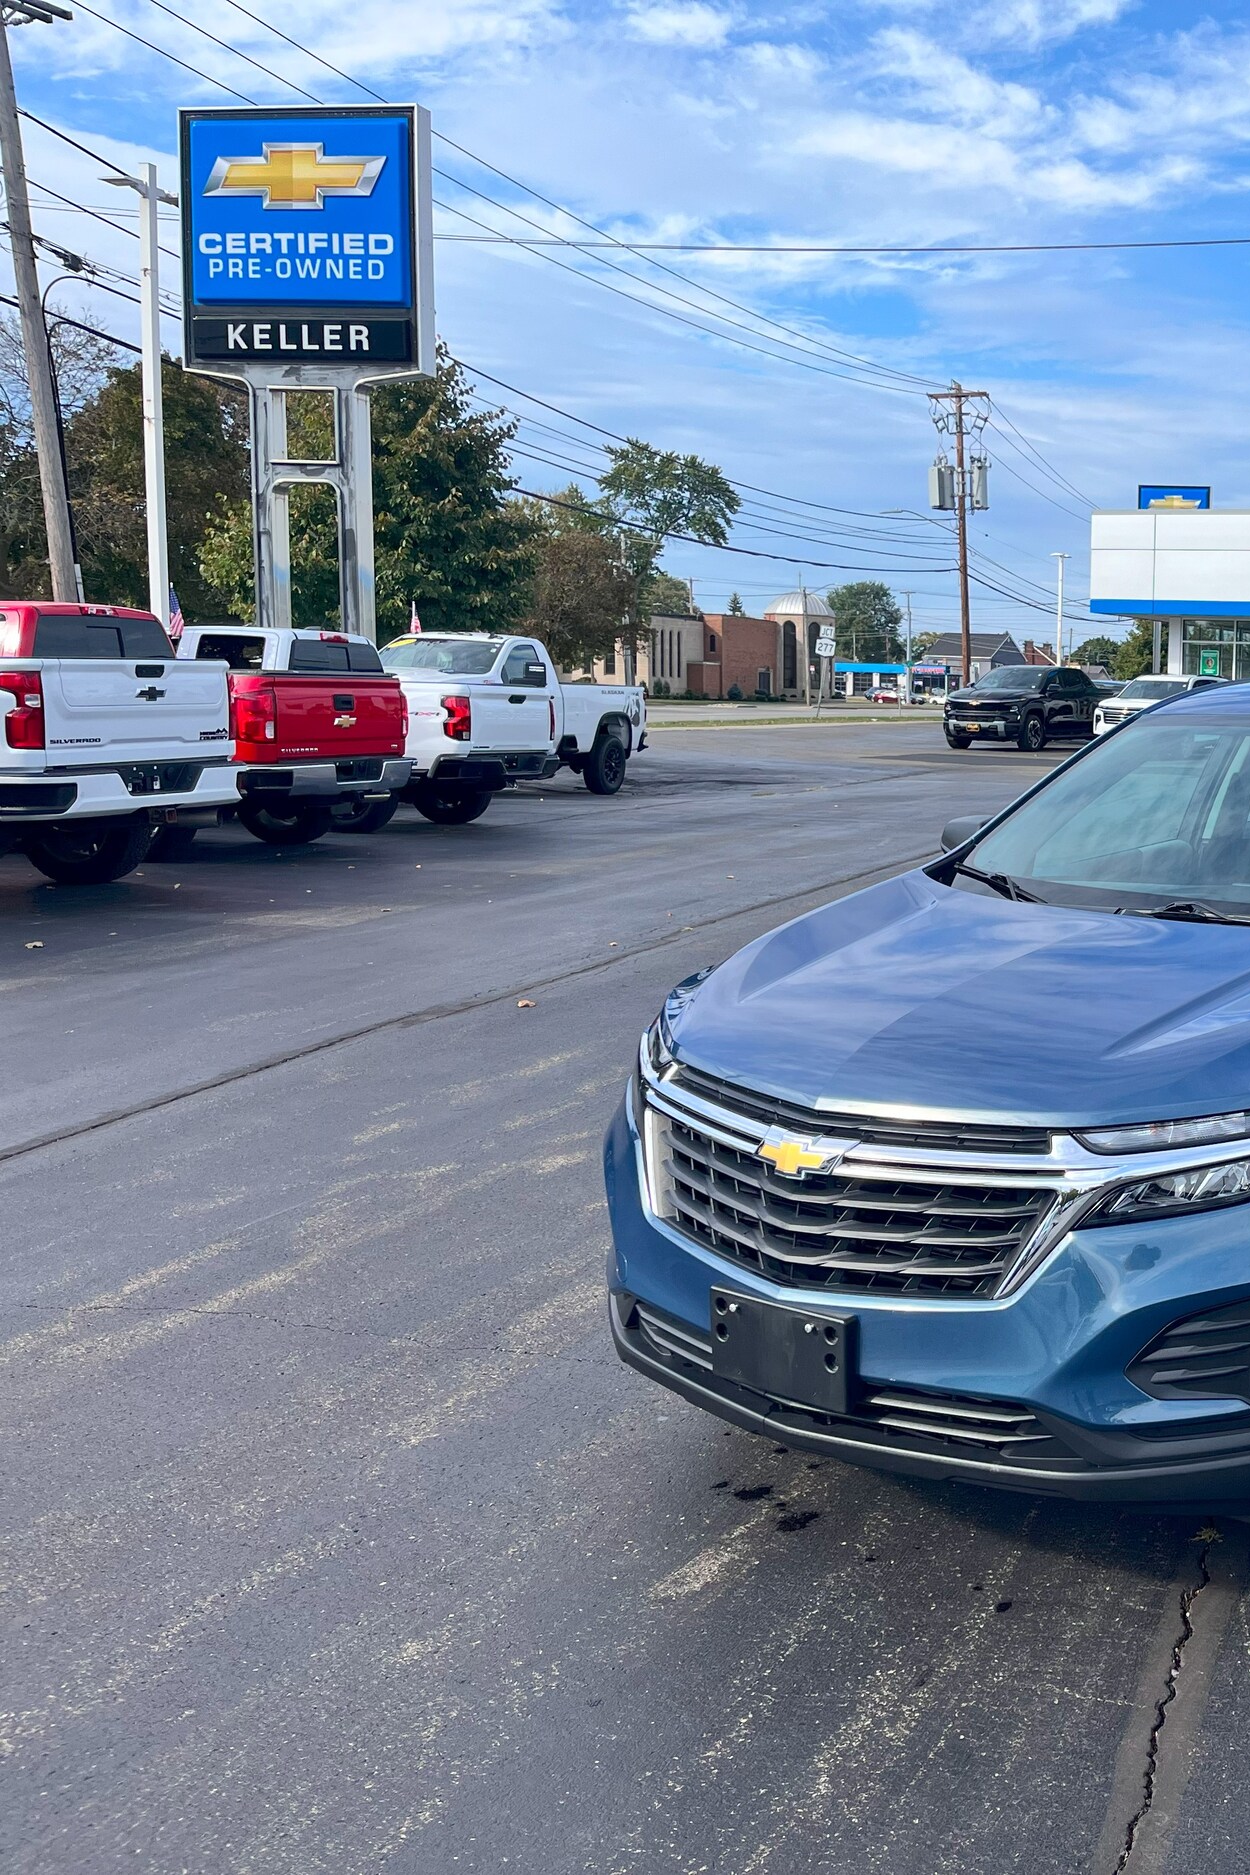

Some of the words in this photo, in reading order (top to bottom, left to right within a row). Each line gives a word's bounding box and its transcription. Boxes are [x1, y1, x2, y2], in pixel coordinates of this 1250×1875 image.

[198, 232, 394, 255] CERTIFIED
[208, 258, 385, 280] PRE-OWNED
[226, 323, 370, 351] KELLER
[821, 627, 834, 637] JCT
[817, 642, 834, 652] 277
[49, 737, 101, 745] SILVERADO
